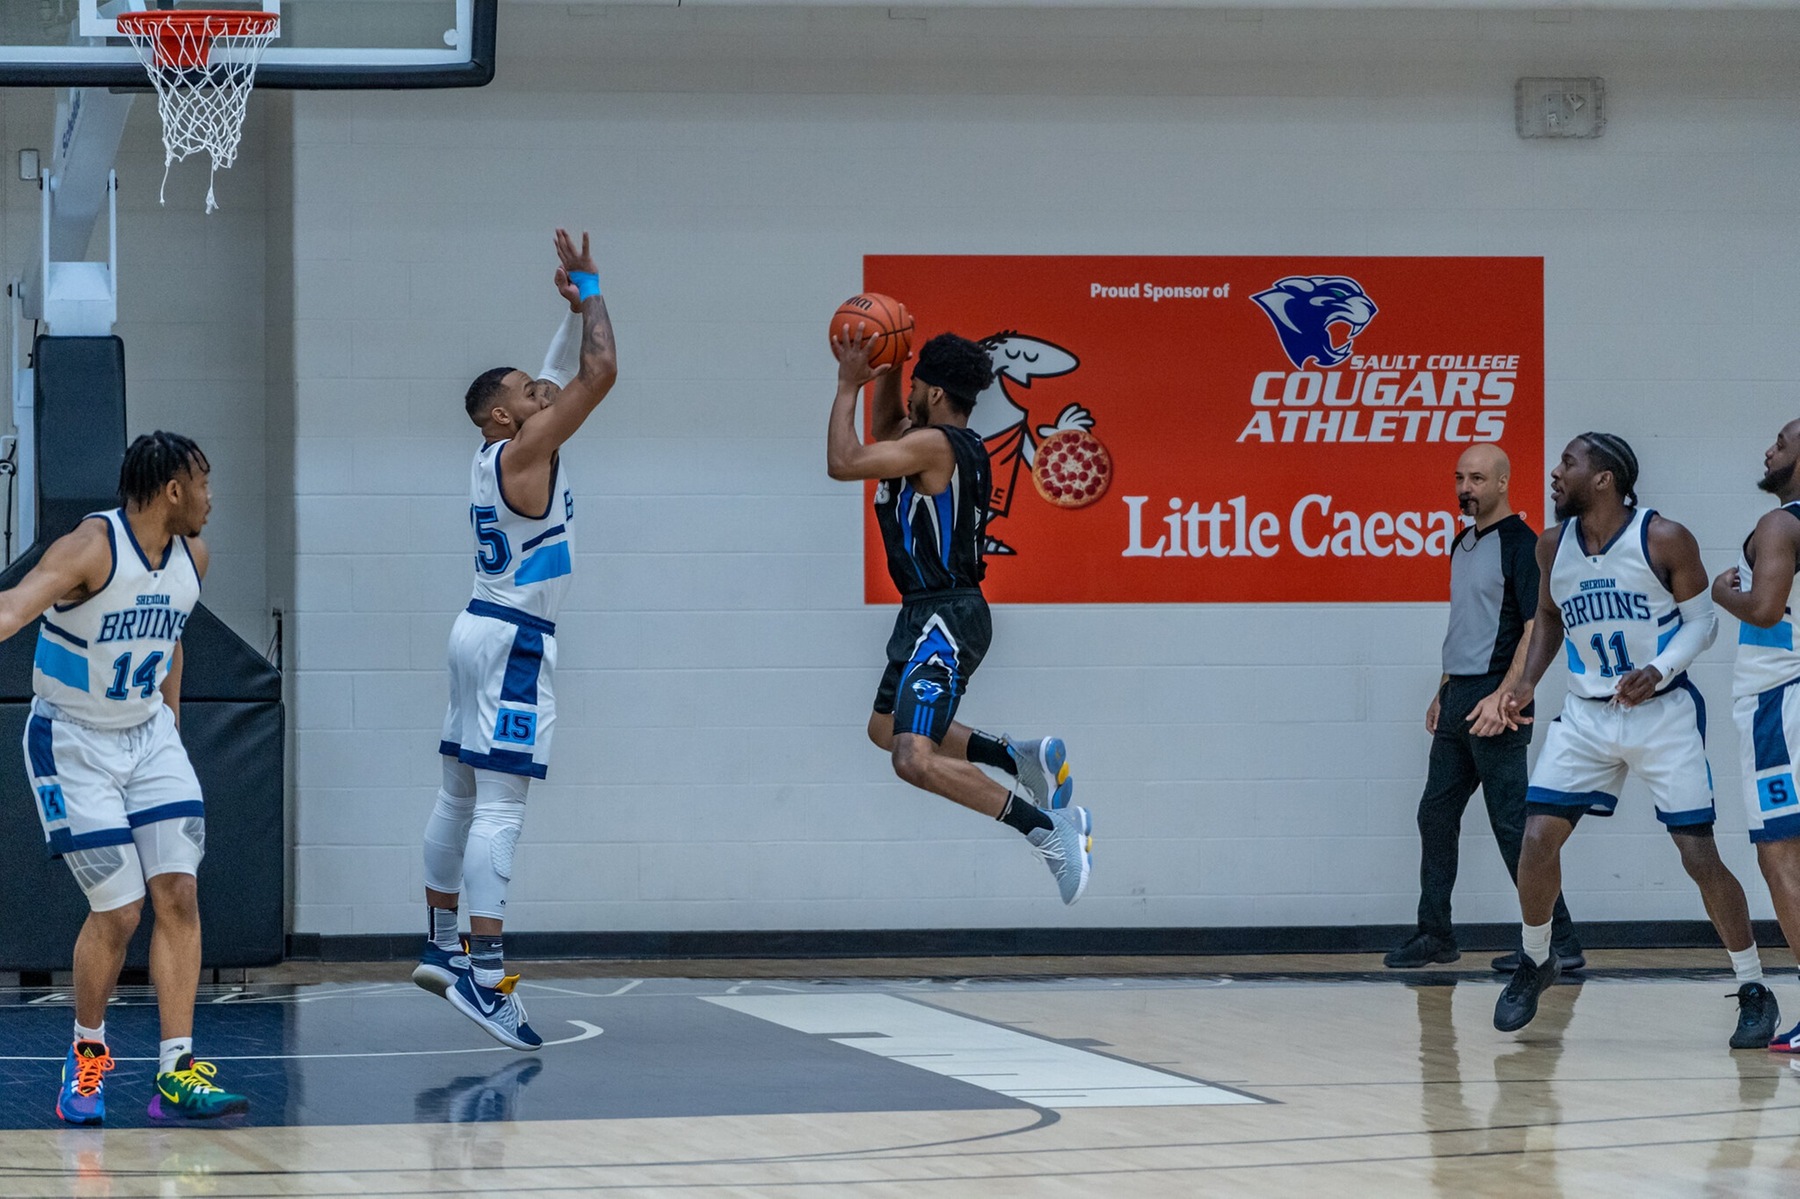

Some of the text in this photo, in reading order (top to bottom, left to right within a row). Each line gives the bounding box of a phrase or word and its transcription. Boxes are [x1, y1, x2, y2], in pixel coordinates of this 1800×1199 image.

[1090, 283, 1230, 302] Proud Sponsor of
[1350, 355, 1520, 370] SAULT COLLEGE
[1250, 371, 1517, 407] COUGARS
[1235, 410, 1506, 443] ATHLETICS
[1121, 494, 1476, 558] Little Caesa
[1580, 579, 1616, 592] SHERIDAN
[1561, 591, 1651, 629] BRUINS
[1590, 630, 1635, 678] 11
[105, 651, 164, 701] 14
[498, 712, 533, 741] 15
[1767, 778, 1788, 806] S
